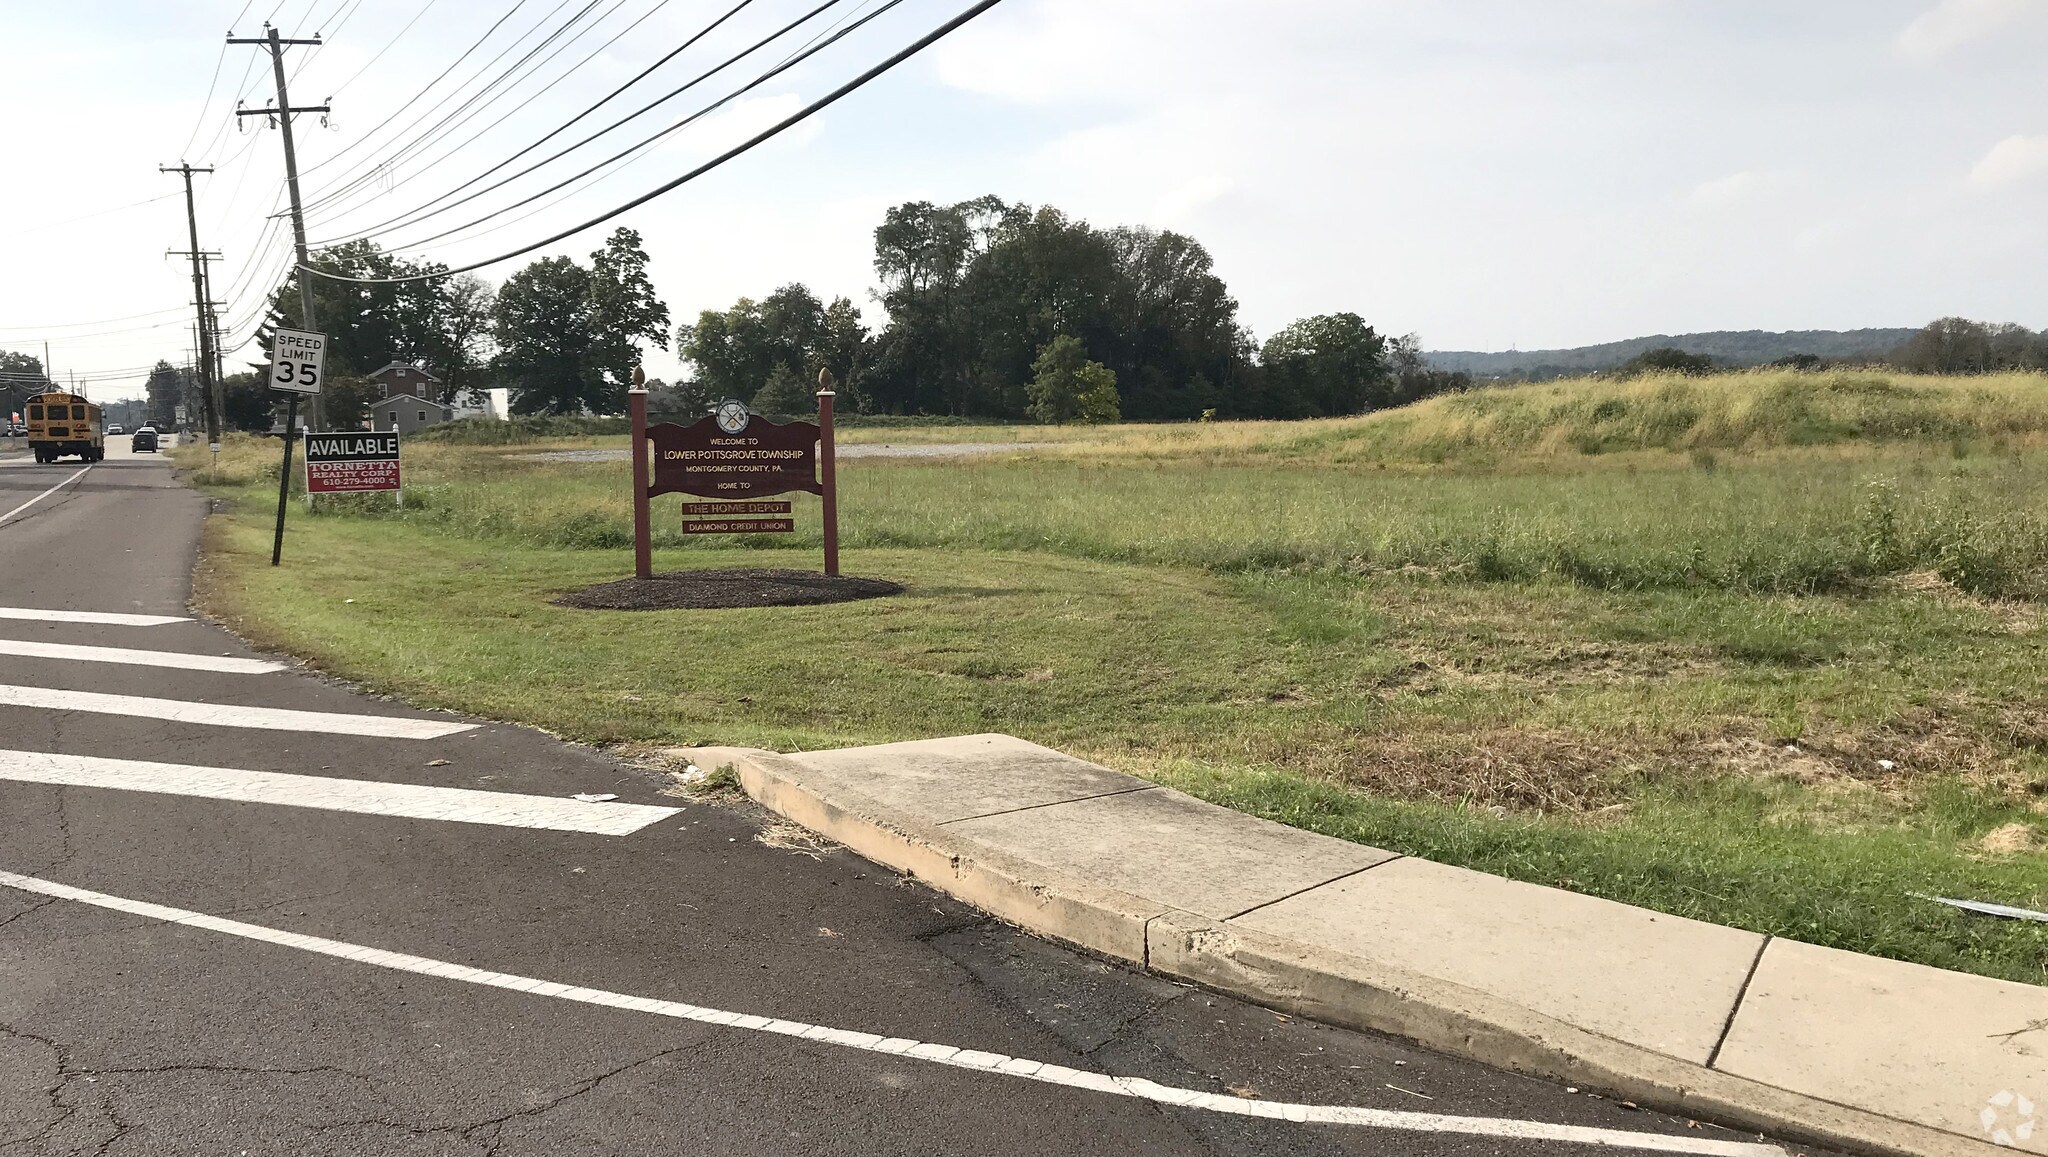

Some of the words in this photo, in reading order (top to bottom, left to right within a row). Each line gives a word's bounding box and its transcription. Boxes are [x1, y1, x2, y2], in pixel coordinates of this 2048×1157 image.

[279, 336, 321, 349] SPEED
[282, 349, 315, 361] LIMIT
[276, 361, 316, 386] 35
[710, 438, 746, 446] WELCOME
[748, 438, 758, 446] TO
[309, 439, 396, 456] AVAILABLE
[664, 450, 696, 460] LOWER
[698, 450, 756, 460] POTTSGROVE
[757, 450, 804, 460] TOWNSHIP
[309, 462, 397, 472] TORNETTA
[686, 465, 737, 473] MONTGOMERY
[738, 465, 770, 473] COUNTY,
[323, 477, 386, 486] 610-279-4000
[688, 504, 708, 514] THE
[712, 504, 745, 513] HOME
[749, 504, 784, 513] DEPOT
[689, 523, 728, 531] DIAMOND
[730, 522, 758, 531] CREDIT
[760, 522, 786, 530] UNION
